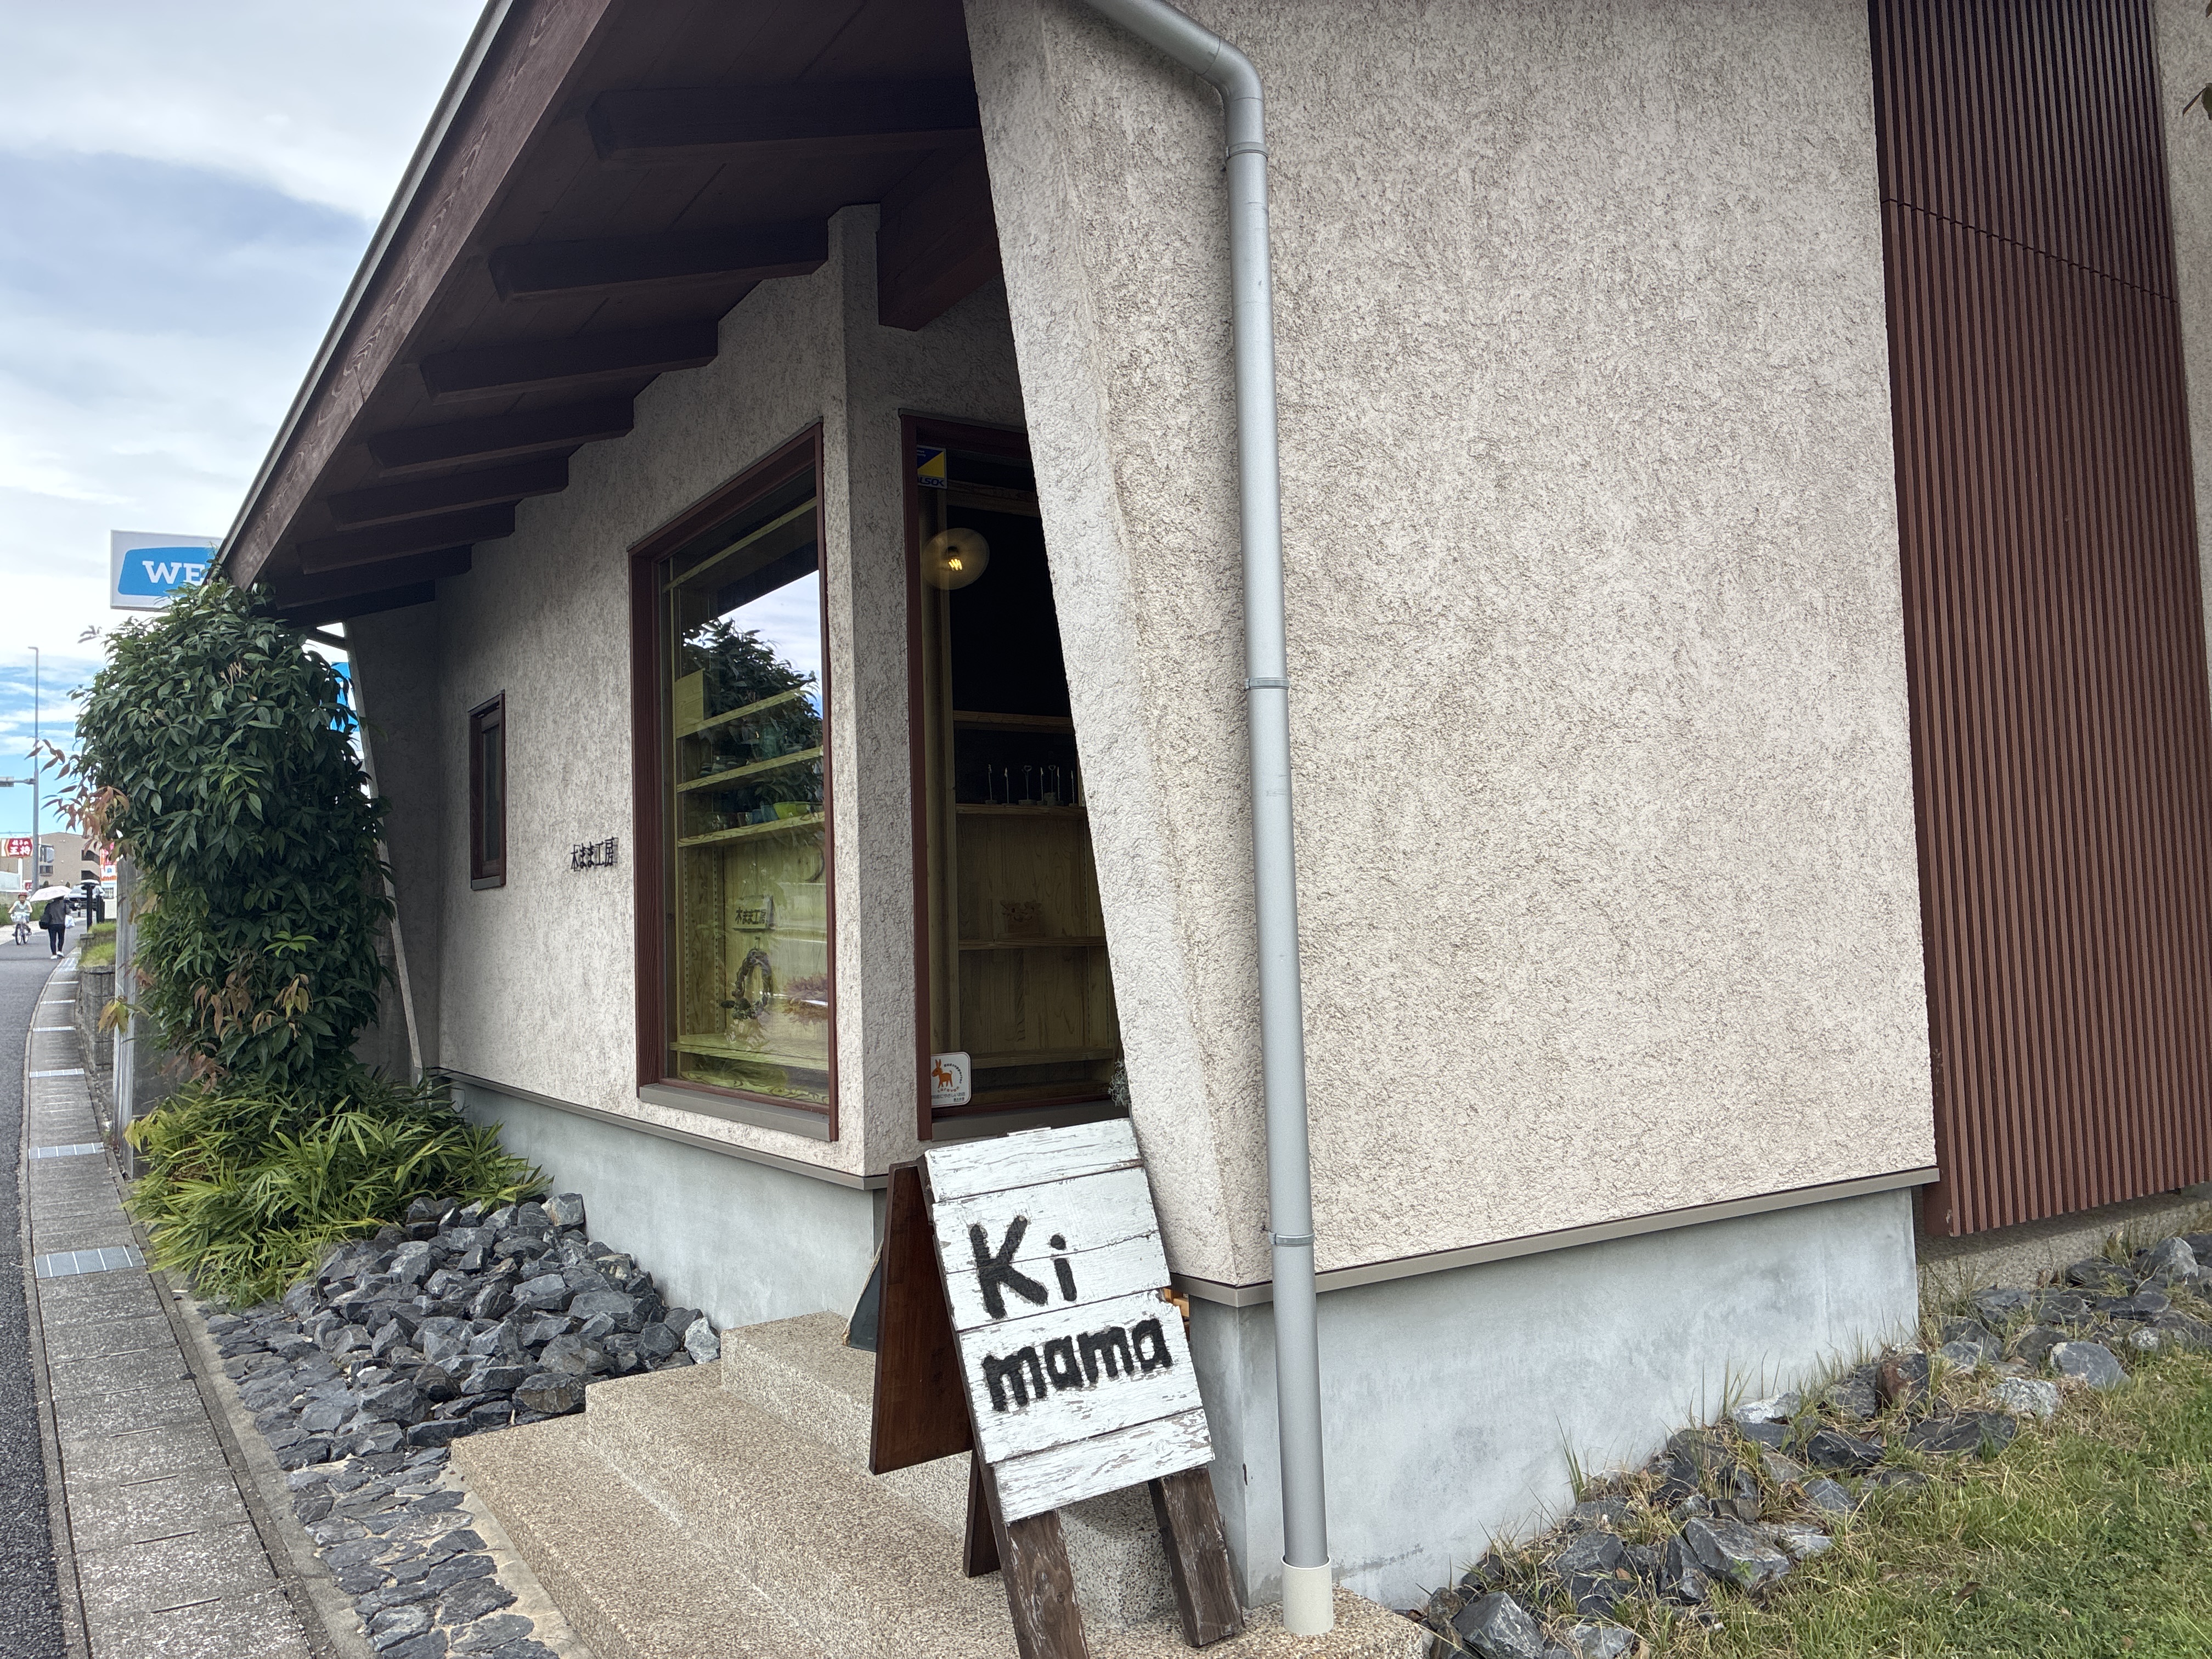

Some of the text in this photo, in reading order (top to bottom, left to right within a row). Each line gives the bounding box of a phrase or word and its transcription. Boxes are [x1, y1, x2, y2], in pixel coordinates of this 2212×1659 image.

[917, 476, 944, 487] LSOK
[9, 845, 31, 855] 王将
[571, 836, 614, 871] 木まま工房
[969, 1215, 1077, 1319] Ki
[981, 1318, 1173, 1412] mama
